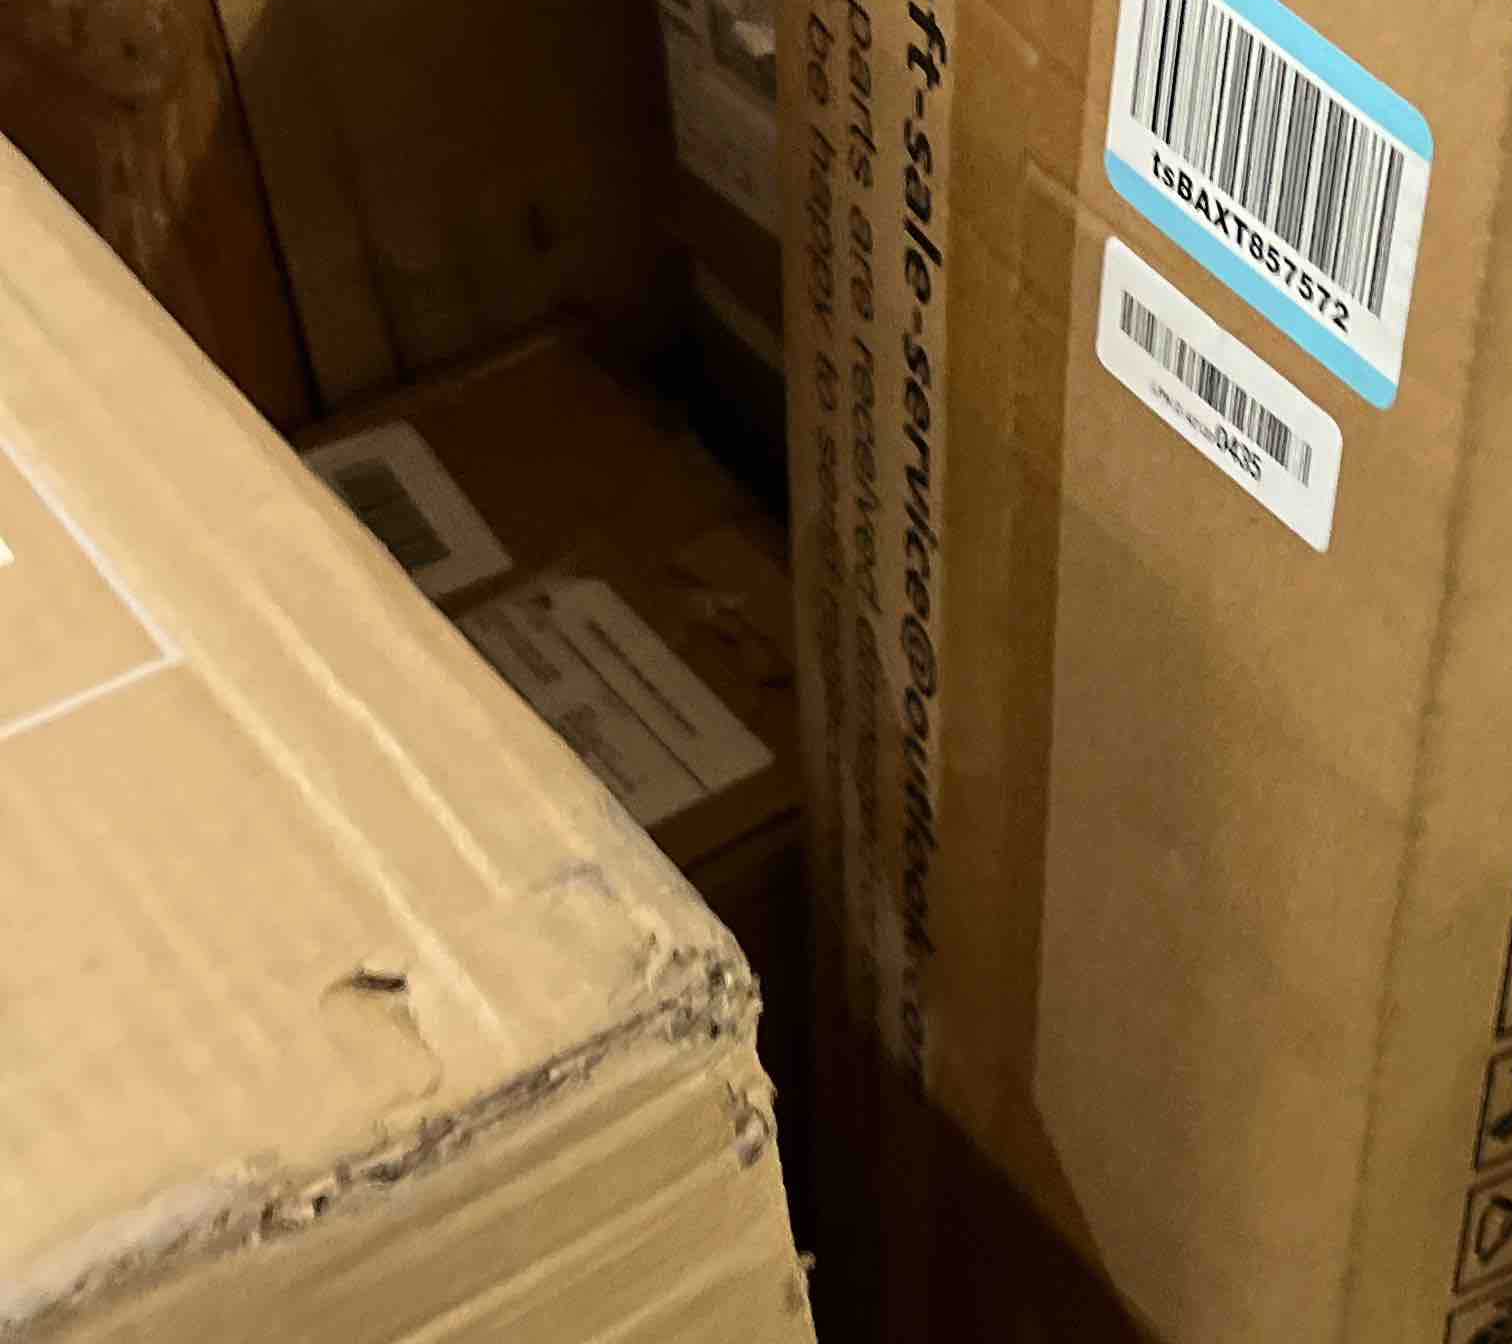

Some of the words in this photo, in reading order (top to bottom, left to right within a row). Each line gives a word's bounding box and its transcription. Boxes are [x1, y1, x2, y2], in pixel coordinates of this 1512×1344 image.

[806, 9, 833, 110] be
[847, 203, 876, 321] are
[1152, 150, 1350, 334] tsBAXT857572
